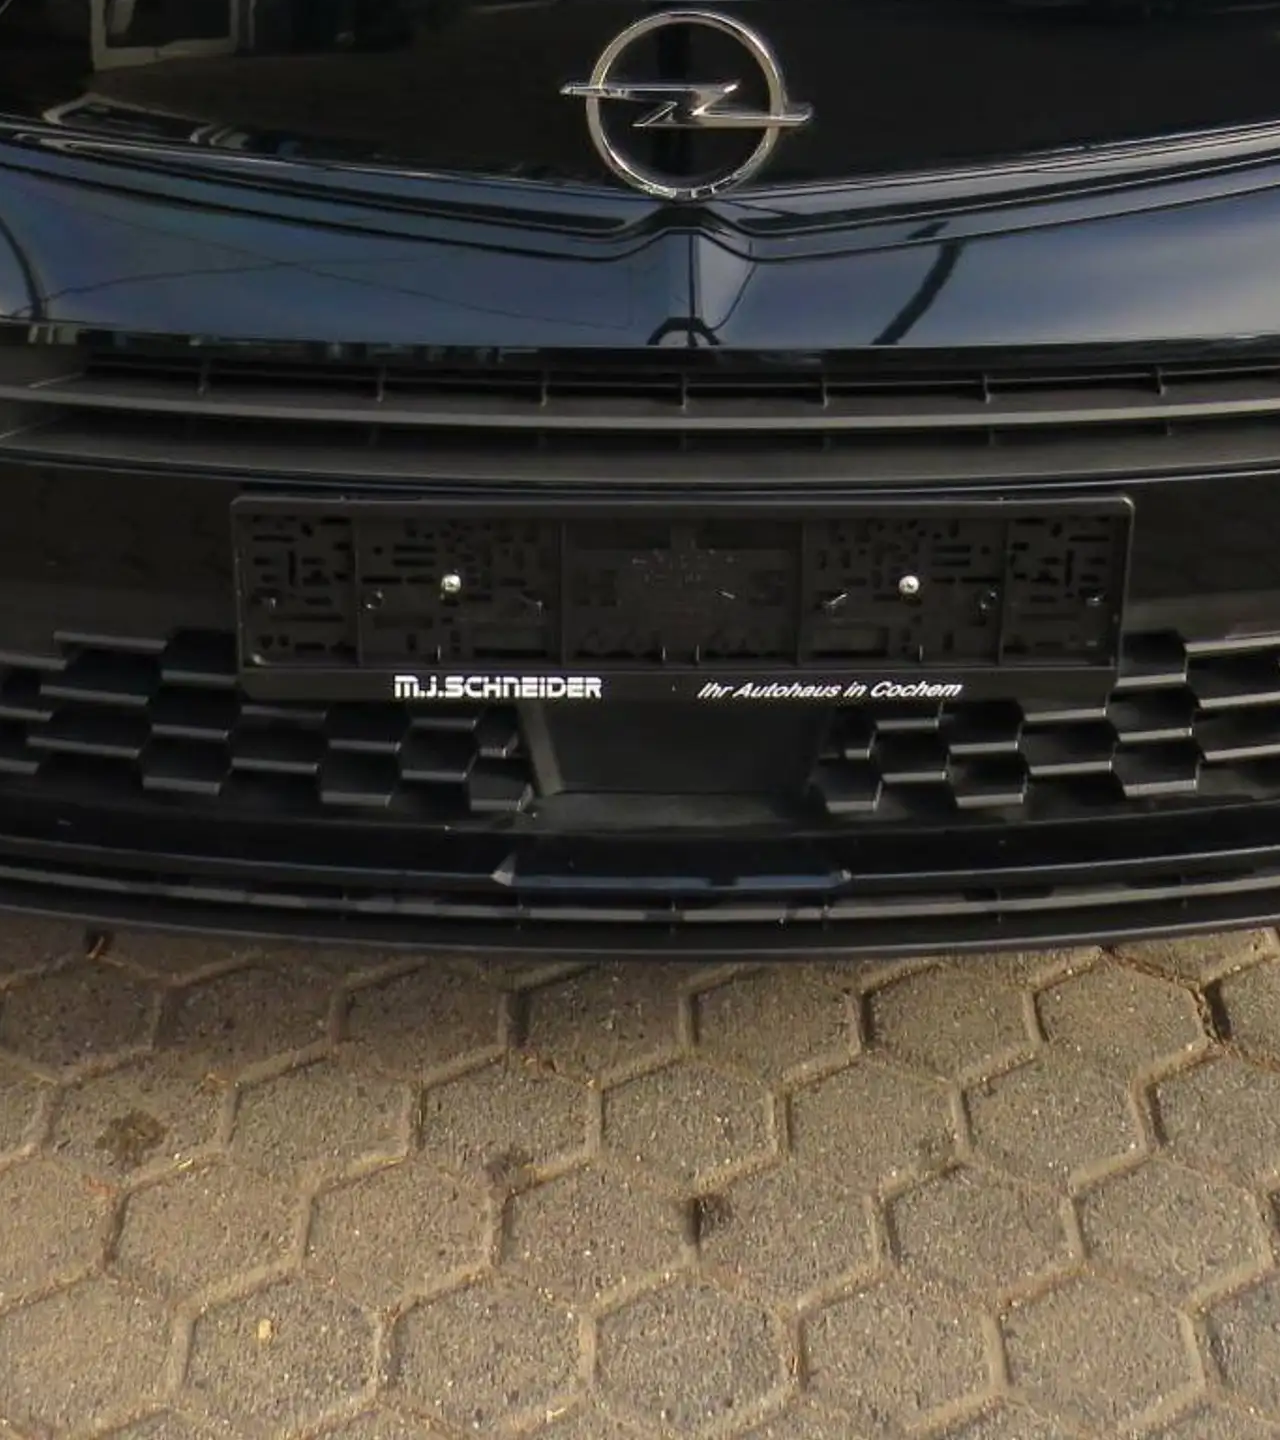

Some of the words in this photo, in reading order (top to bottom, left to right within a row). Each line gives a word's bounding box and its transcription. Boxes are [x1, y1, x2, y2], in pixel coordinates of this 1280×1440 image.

[697, 681, 733, 699] Ihr
[732, 682, 842, 699] Autohaus
[842, 680, 869, 699] in
[870, 680, 964, 698] Cochem
